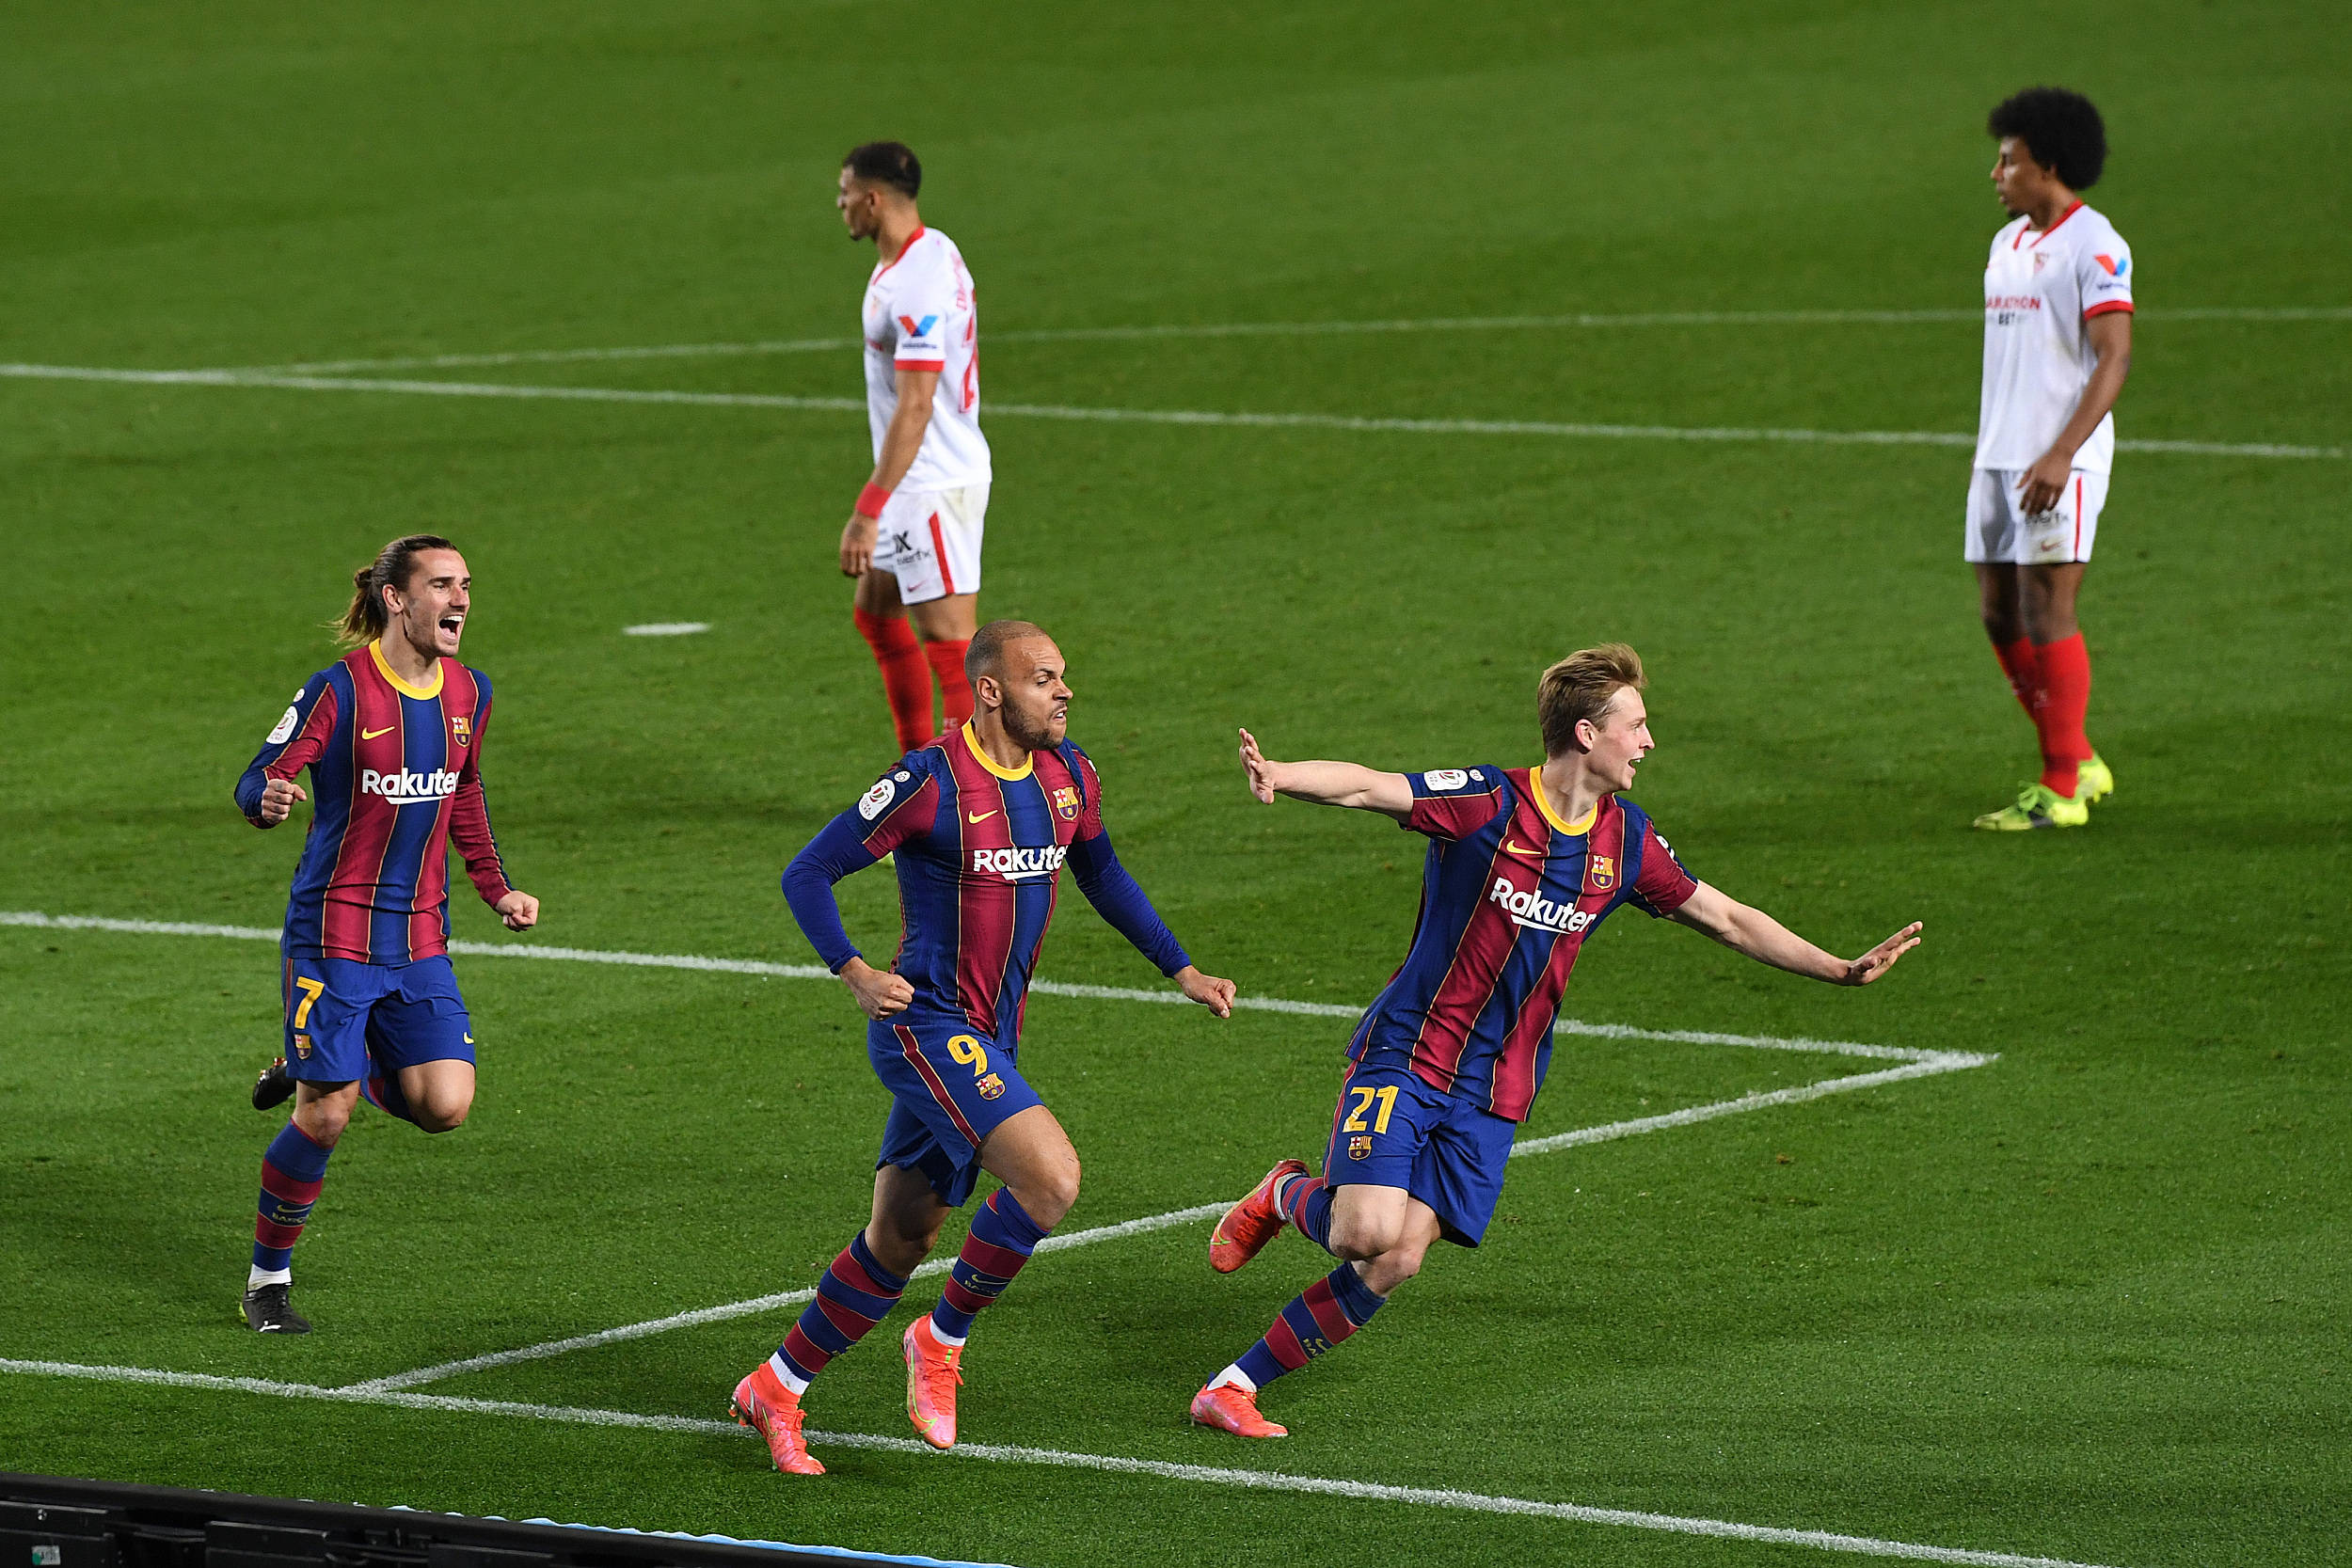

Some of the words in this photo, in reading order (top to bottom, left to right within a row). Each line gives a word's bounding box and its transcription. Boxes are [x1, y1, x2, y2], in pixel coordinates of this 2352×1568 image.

[1985, 295, 2041, 310] ARATHON
[973, 845, 1069, 872] Rakute
[294, 975, 326, 1029] 7
[946, 1034, 988, 1078] 9
[1342, 1085, 1400, 1135] 21
